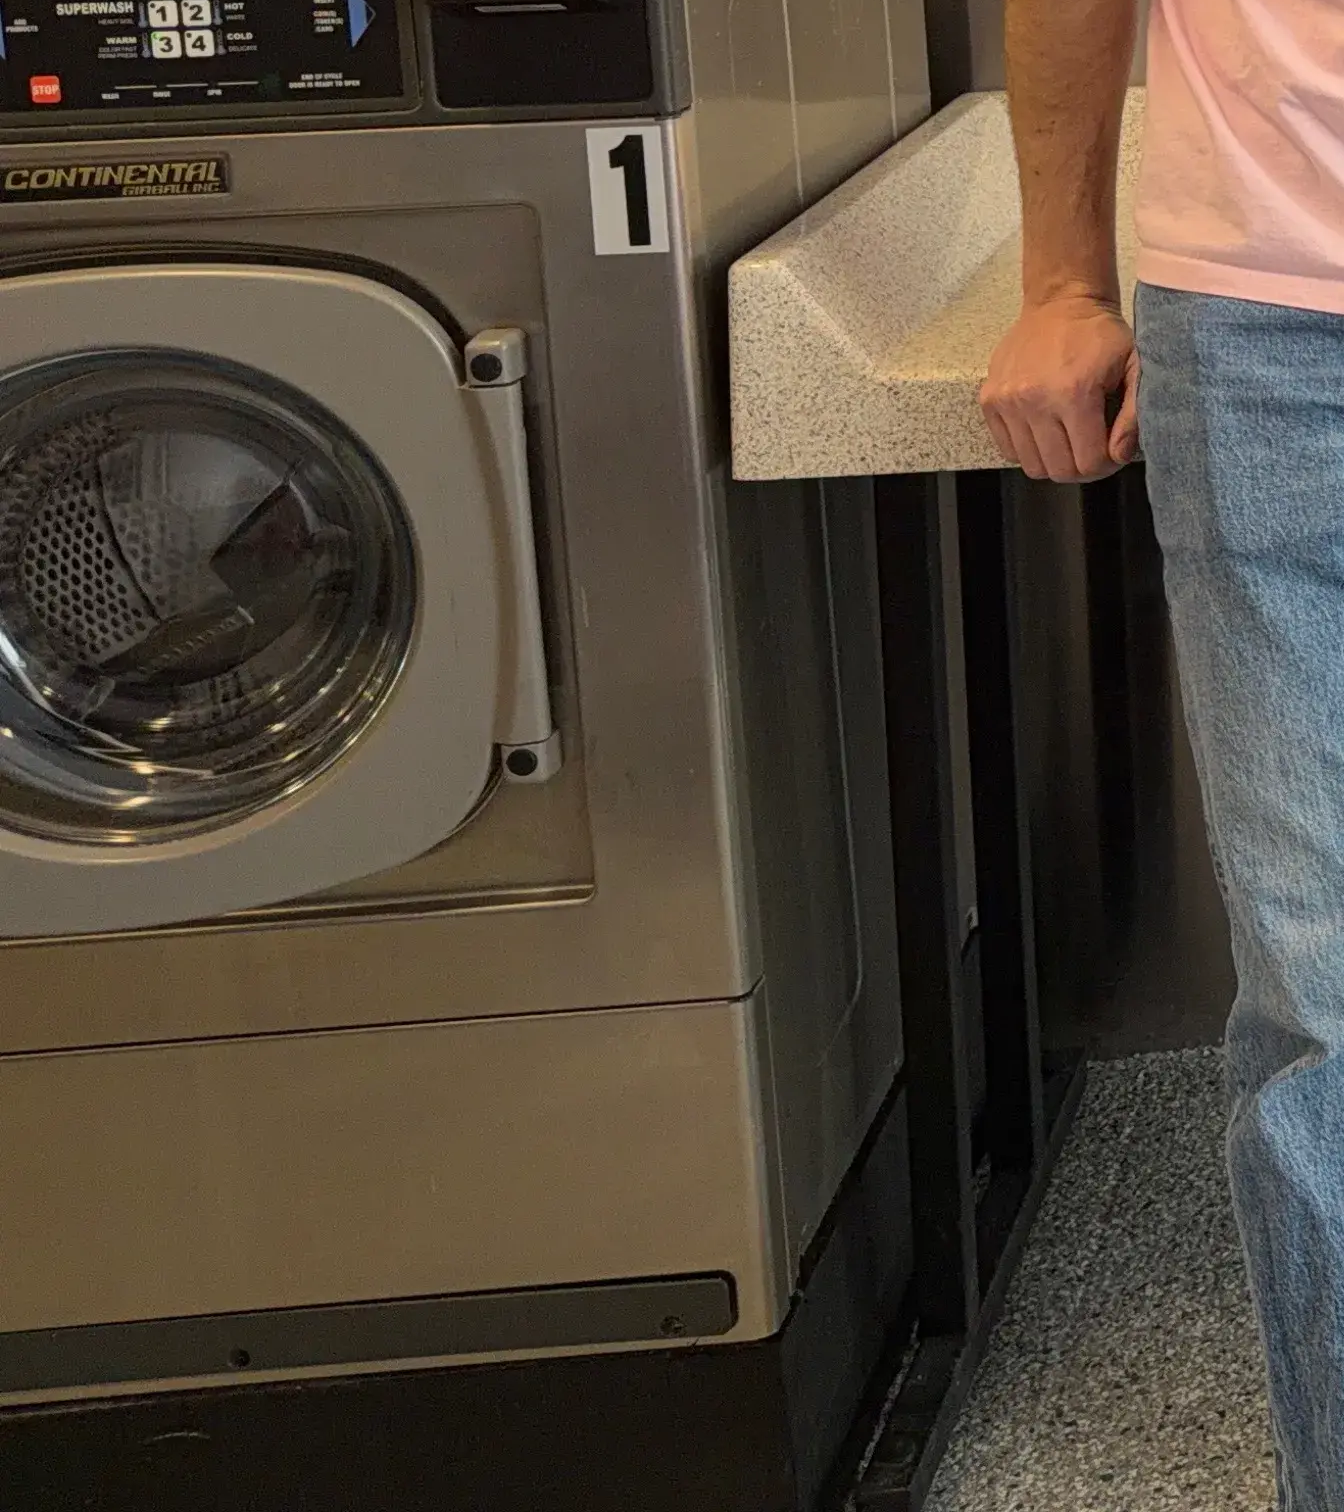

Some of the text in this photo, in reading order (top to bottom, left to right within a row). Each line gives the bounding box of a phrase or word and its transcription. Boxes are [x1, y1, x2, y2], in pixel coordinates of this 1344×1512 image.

[56, 1, 134, 16] SUPERWASH
[156, 6, 167, 22] 1
[189, 5, 204, 21] 2
[224, 2, 244, 10] HOT
[106, 37, 137, 45] WARM
[191, 35, 206, 51] 4
[226, 32, 253, 40] COLD
[159, 37, 174, 53] 3
[32, 85, 60, 96] STOP
[4, 161, 220, 189] CONTINENTAL
[608, 133, 651, 246] 1
